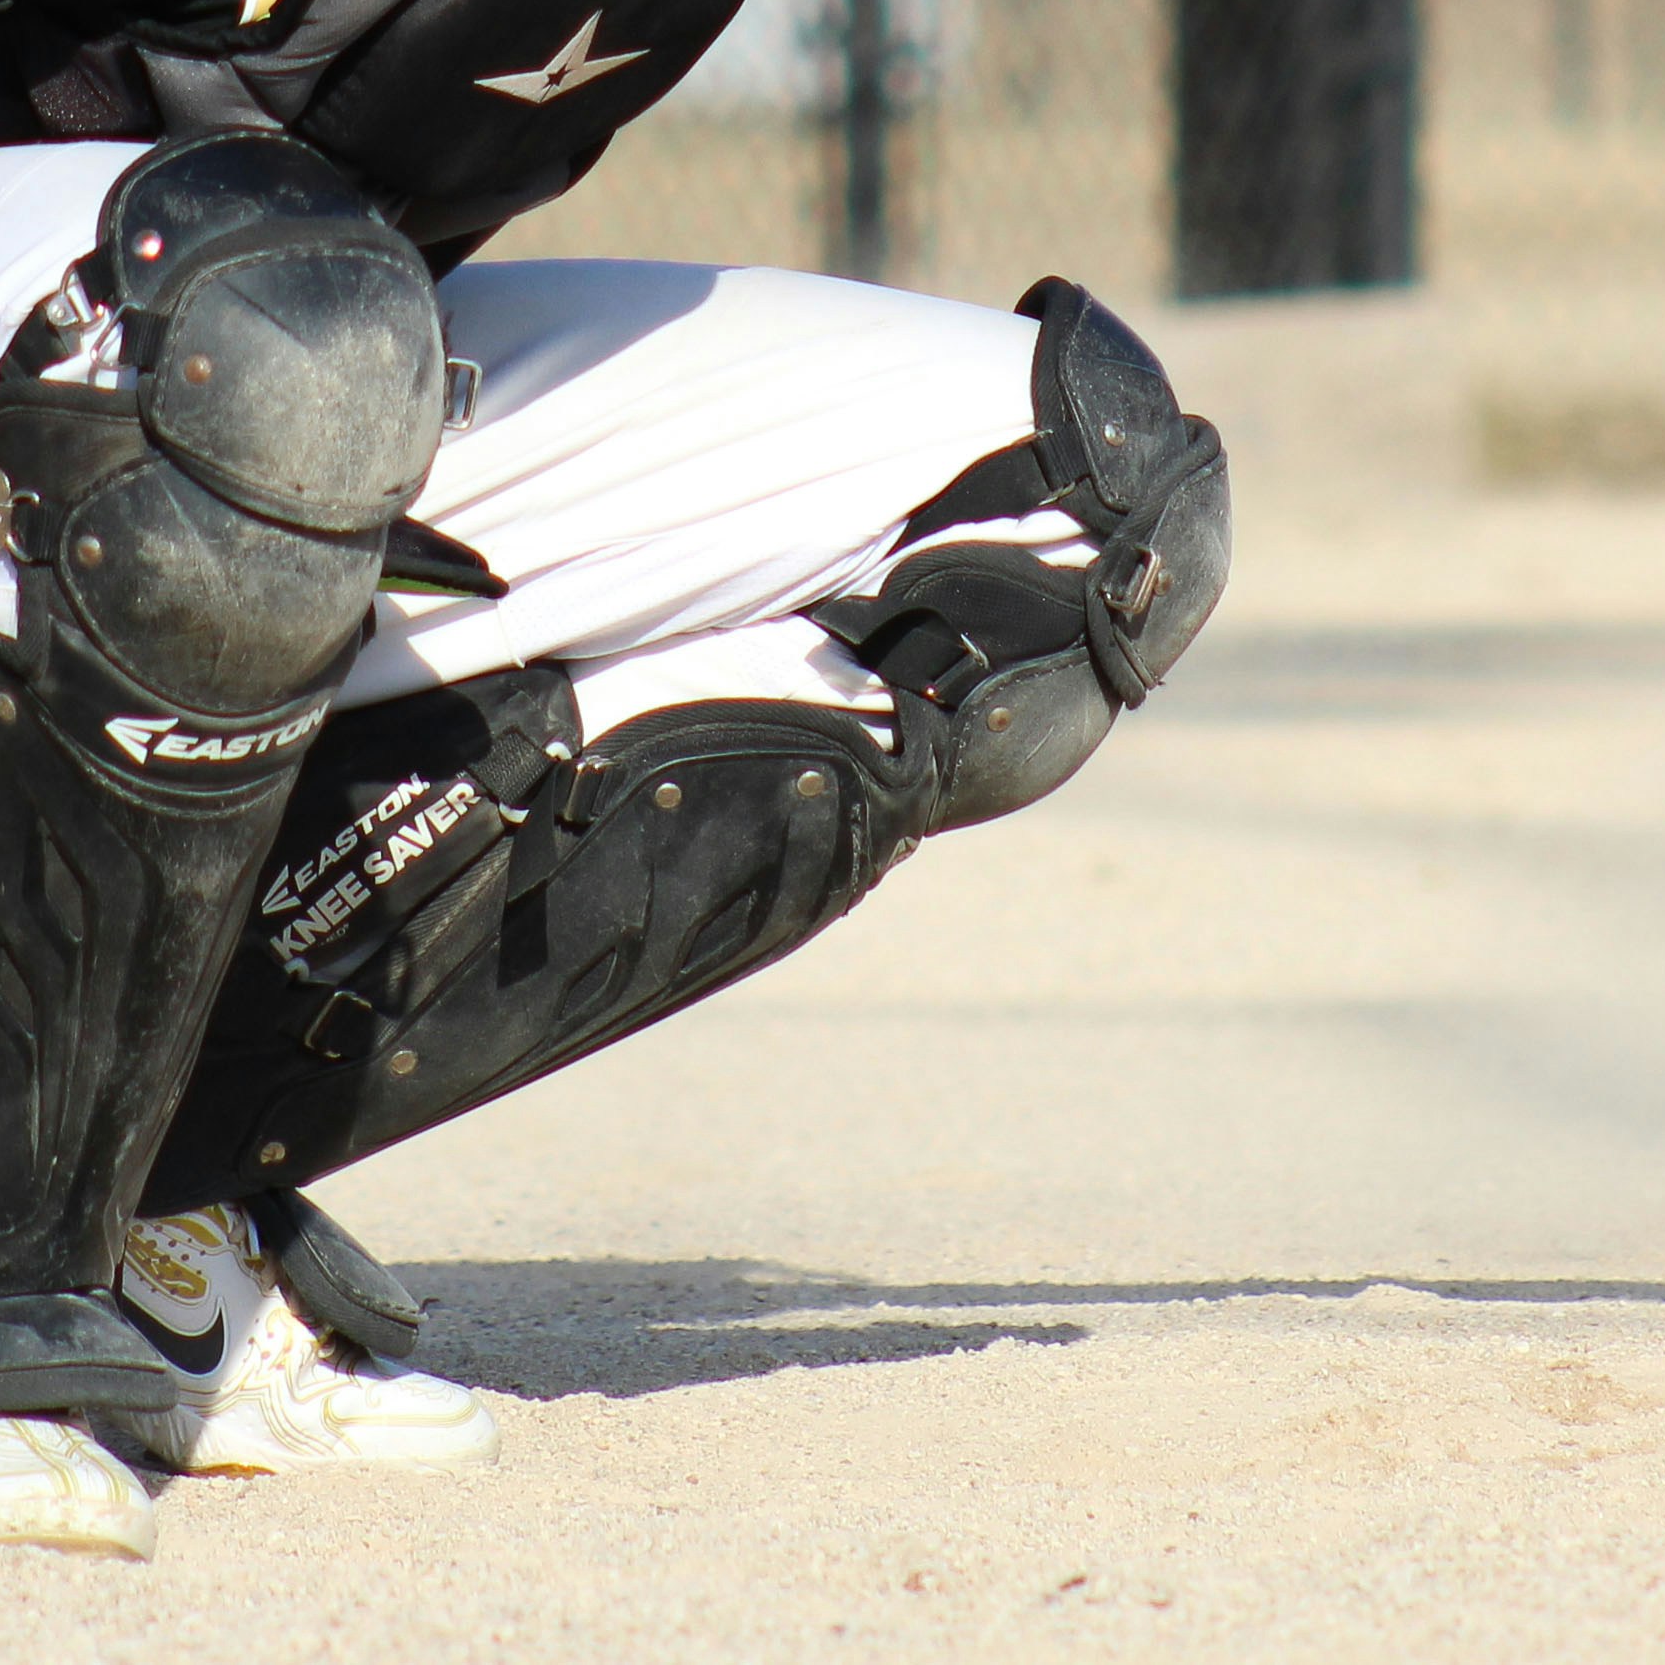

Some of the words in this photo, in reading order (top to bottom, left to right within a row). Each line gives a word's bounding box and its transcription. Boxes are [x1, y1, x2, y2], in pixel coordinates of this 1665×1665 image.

[153, 698, 332, 761] EASTON
[269, 870, 371, 960] KNEE
[363, 782, 481, 884] SAVER
